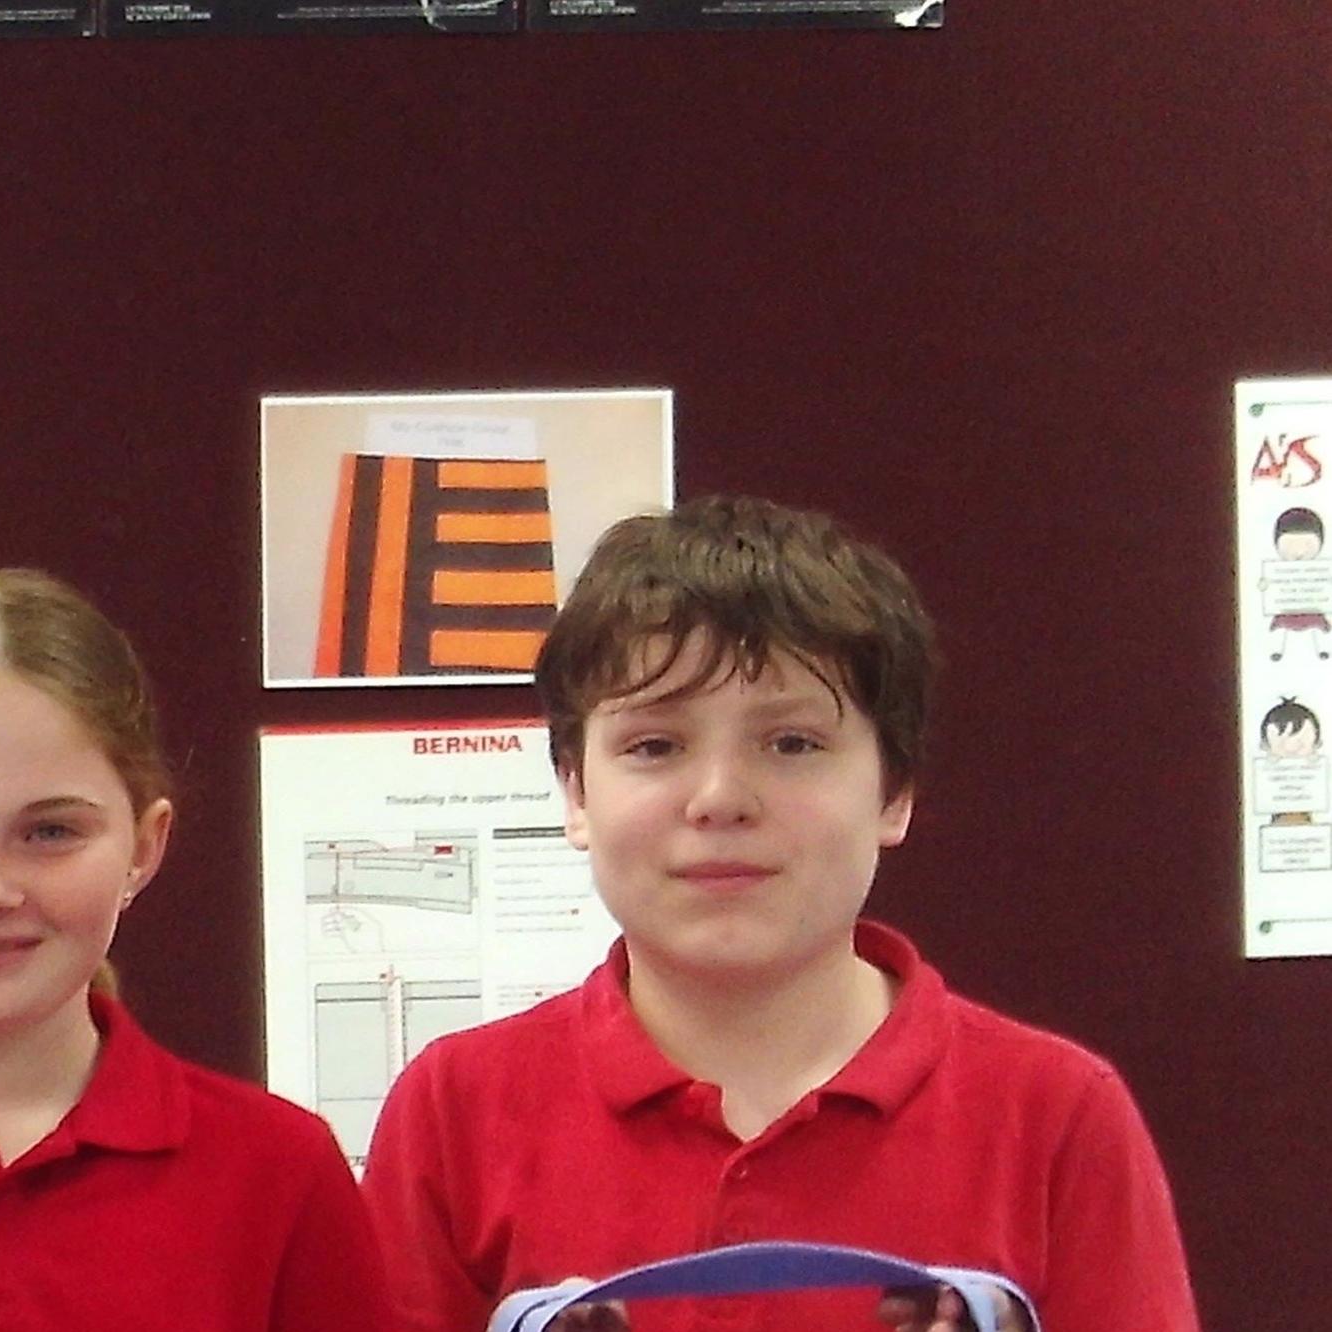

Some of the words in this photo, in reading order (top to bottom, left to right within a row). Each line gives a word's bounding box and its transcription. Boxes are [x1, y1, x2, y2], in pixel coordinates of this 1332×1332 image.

[413, 735, 523, 755] BERNINA
[449, 793, 468, 803] the
[472, 793, 507, 805] upper
